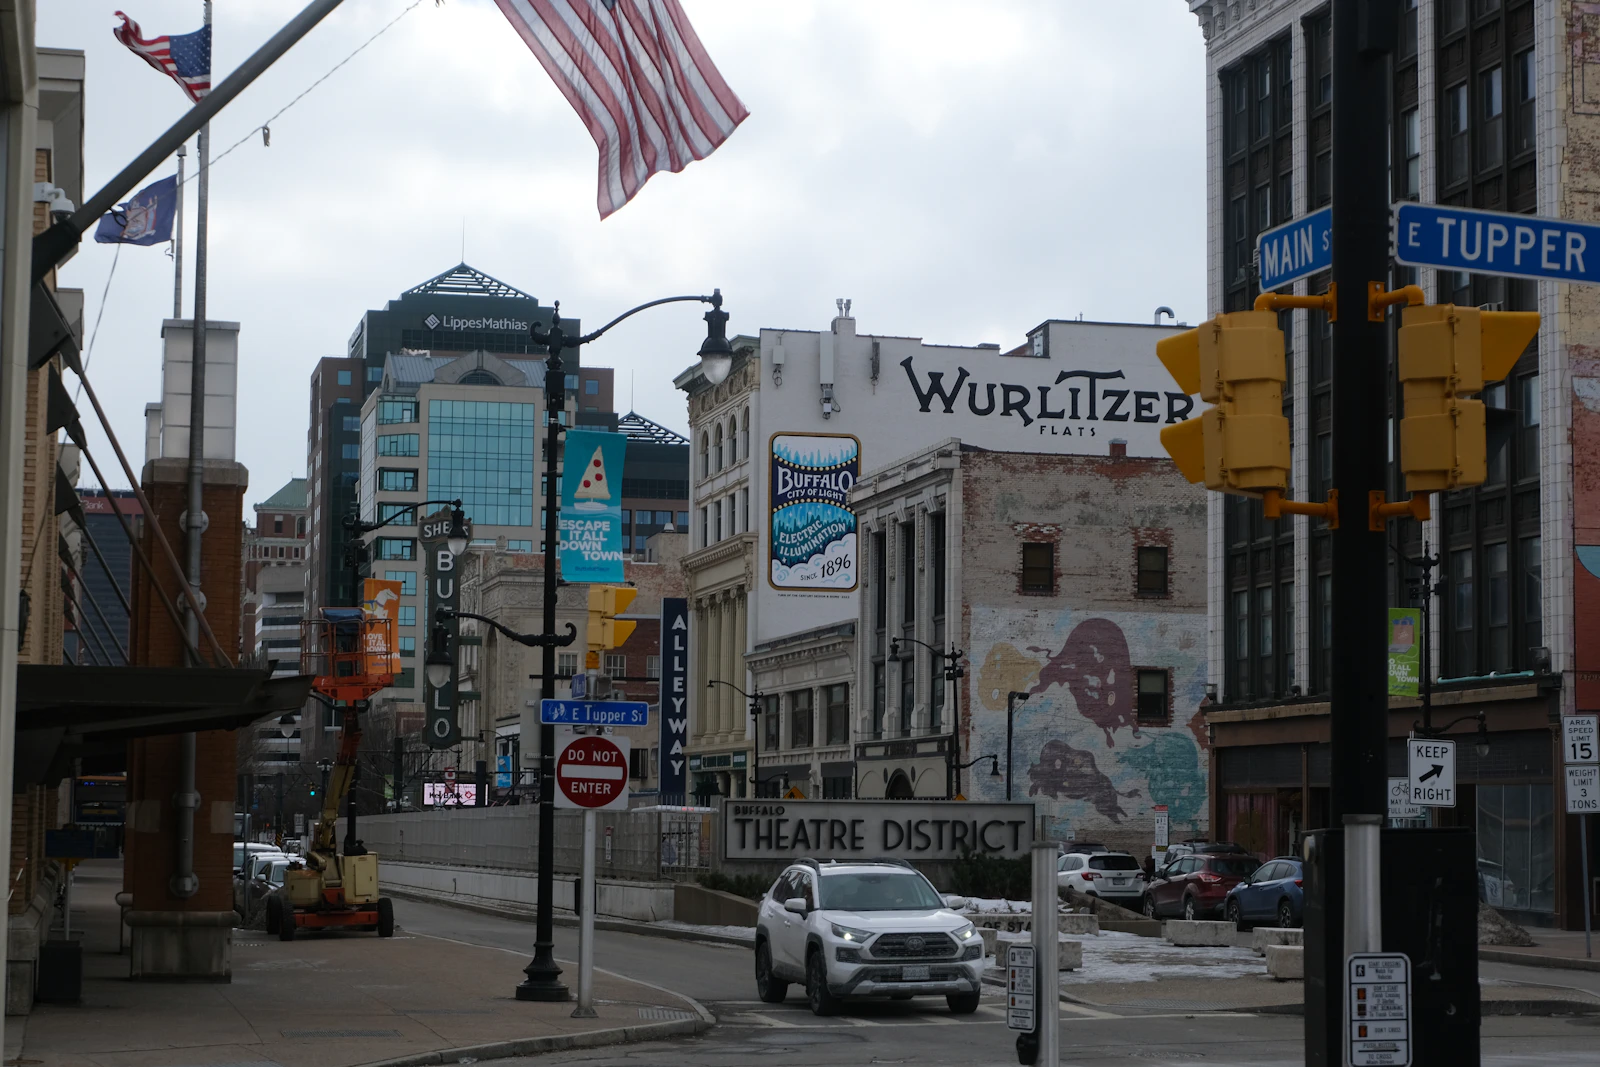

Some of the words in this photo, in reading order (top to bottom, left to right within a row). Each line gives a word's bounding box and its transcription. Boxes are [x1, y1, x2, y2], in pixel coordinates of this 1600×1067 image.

[1408, 221, 1421, 247] E
[1436, 216, 1586, 273] TUPPER
[1264, 224, 1313, 281] MAIN
[1322, 228, 1333, 251] S
[443, 315, 528, 331] LippesMathias
[900, 356, 1194, 427] WURLITZER
[1039, 425, 1096, 437] FLATS
[777, 465, 853, 496] BUFFALO
[787, 489, 805, 500] CITY
[807, 487, 818, 496] OF
[818, 488, 844, 501] LIGHT
[558, 519, 611, 531] ESCAPE
[779, 519, 823, 545] ELECTRIC
[560, 540, 602, 551] DOWN
[779, 522, 846, 557] ILLUMINATION
[582, 550, 624, 561] TOWN
[800, 572, 818, 581] SINCE
[820, 554, 852, 579] 1896
[668, 613, 688, 776] ALLEYWAY
[572, 707, 580, 721] E
[584, 704, 627, 724] Tupper
[567, 749, 586, 762] DO
[592, 750, 619, 763] NOT
[1416, 745, 1449, 759] KEEP
[1571, 743, 1593, 760] 15
[1568, 769, 1597, 778] WEIGHT
[570, 781, 612, 795] ENTER
[1573, 778, 1593, 787] LIMIT
[1413, 787, 1452, 801] RIGHT
[1580, 788, 1588, 798] 3
[734, 804, 786, 816] BUFFALO
[1572, 799, 1598, 809] TONS
[734, 818, 865, 850] THEATRE
[882, 818, 1026, 851] DISTRICT
